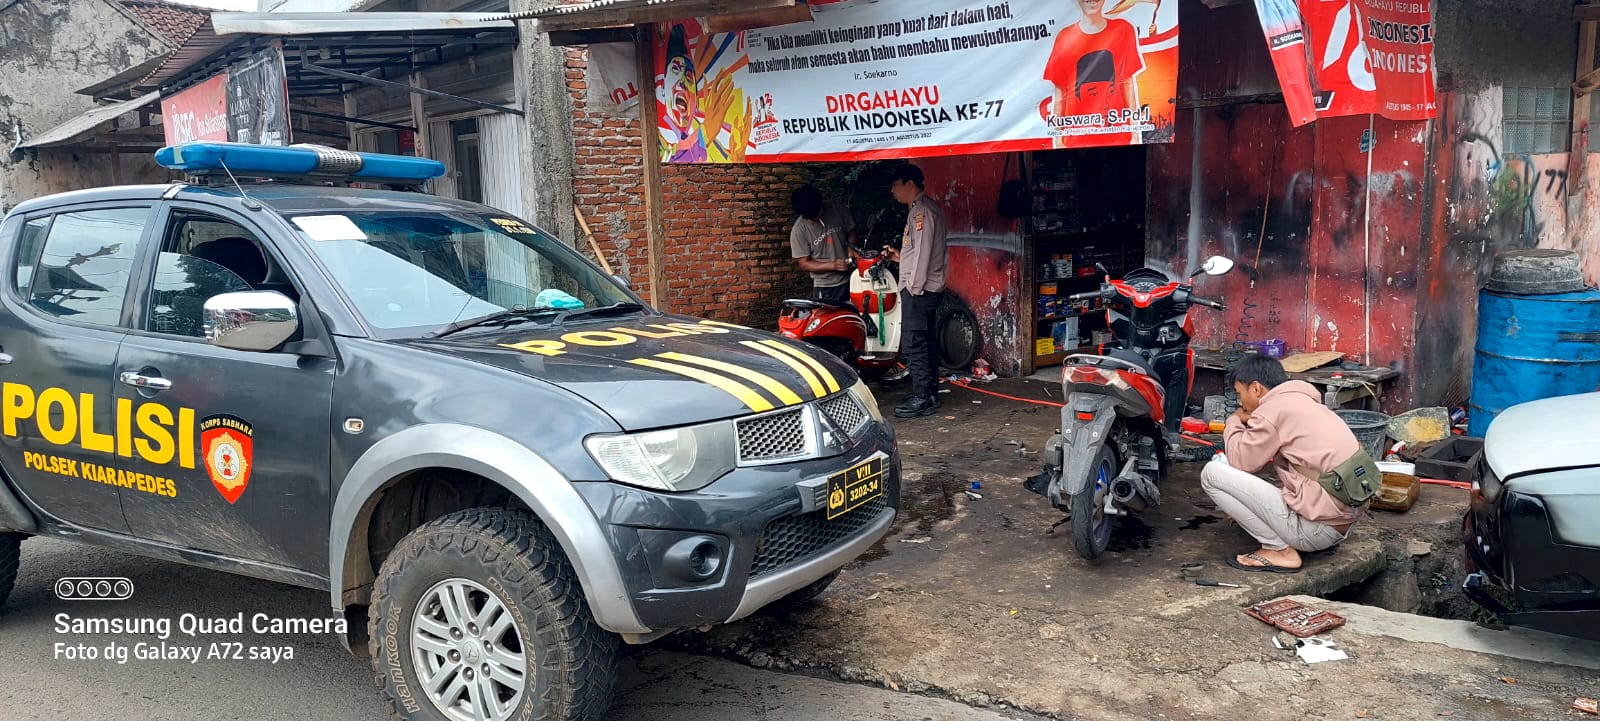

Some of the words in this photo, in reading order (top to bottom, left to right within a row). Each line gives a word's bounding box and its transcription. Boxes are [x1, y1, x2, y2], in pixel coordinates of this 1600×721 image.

[781, 34, 794, 50] kita
[795, 29, 828, 48] memiliki
[828, 25, 876, 44] keinginan
[877, 22, 901, 39] yang
[903, 16, 926, 33] kuat
[928, 12, 949, 30] dari
[950, 8, 985, 27] dalam
[987, 1, 1013, 21] hati,
[748, 59, 766, 74] maka
[766, 56, 791, 73] seluruh
[791, 55, 809, 70] alam
[810, 50, 847, 68] semesta
[847, 48, 871, 64] akan
[870, 44, 896, 61] bahu
[897, 36, 949, 58] membahu
[863, 69, 898, 80] Soekarno
[783, 115, 850, 135] REPUBLIK
[853, 107, 952, 131] INDONESIA
[955, 99, 1004, 121] KE-77
[825, 85, 940, 114] DIRGAHAYU
[1047, 113, 1105, 128] Kuswara,
[1107, 107, 1150, 123] S.Pd.I
[497, 320, 752, 356] POLISI
[2, 382, 195, 469] POLISI
[200, 418, 221, 431] KORPS
[222, 418, 253, 437] SABHARA
[24, 451, 79, 478] POLSEK
[81, 461, 177, 498] KIARAPEDES
[850, 480, 878, 501] 3202-34
